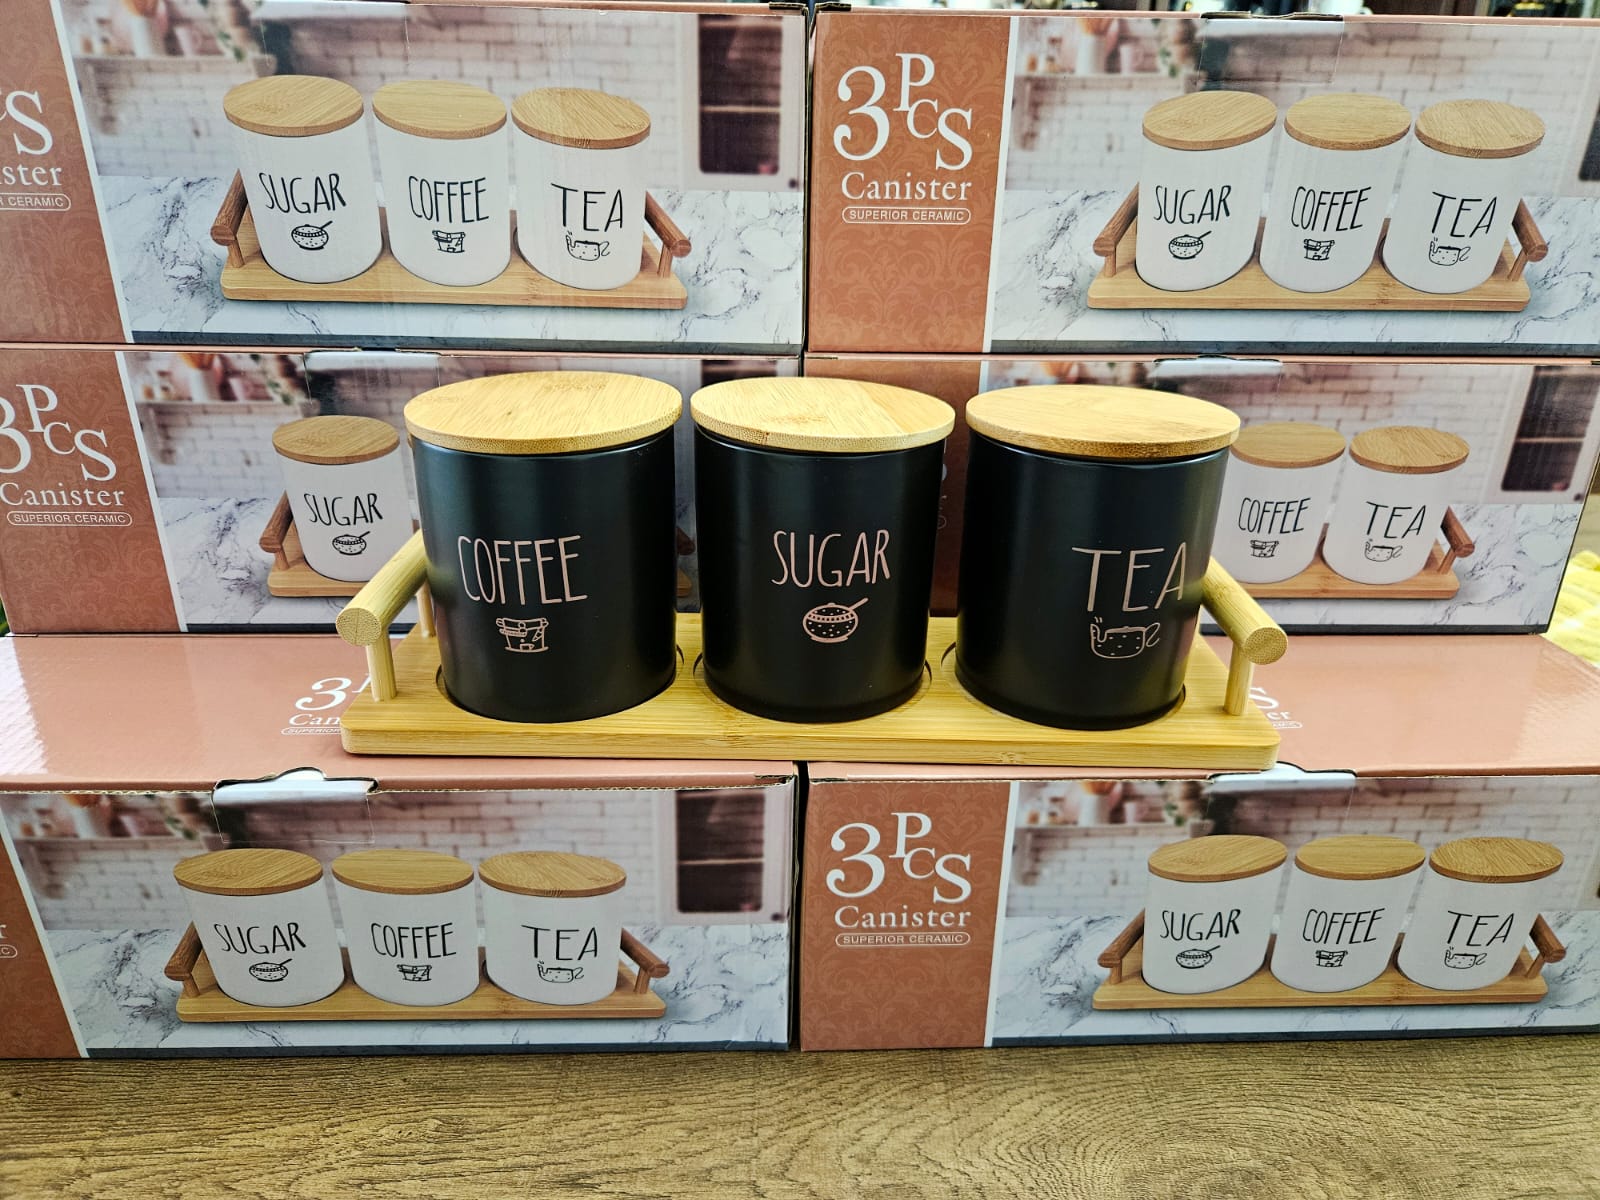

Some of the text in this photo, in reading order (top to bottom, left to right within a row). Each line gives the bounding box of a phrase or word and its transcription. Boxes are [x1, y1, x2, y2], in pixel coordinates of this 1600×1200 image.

[8, 196, 64, 207] CERAMIC
[257, 172, 347, 214] SUGAR
[408, 176, 489, 224] COFFEE
[841, 171, 972, 201] Canister
[1153, 184, 1232, 225] SUGAR
[550, 182, 624, 232] TEA
[849, 209, 965, 221] SUPERIOR CERAMIC
[1290, 185, 1372, 232] COFFEE
[1431, 191, 1497, 238] TEA
[0, 482, 125, 507] Canister
[303, 492, 383, 527] SUGAR
[13, 514, 127, 524] SUPERIOR CERAMIC
[1238, 496, 1312, 533] COFFEE
[1365, 500, 1426, 538] TEA
[457, 535, 589, 605] COFFEE
[771, 529, 892, 588] SUGAR
[1071, 542, 1188, 612] TEA
[834, 905, 971, 929] Canister
[1159, 908, 1242, 941] SUGAR
[1302, 907, 1386, 945] COFFEE
[1446, 910, 1515, 947] TEA
[213, 921, 307, 955] SUGAR
[371, 922, 457, 959] COFFEE
[520, 924, 600, 962] TEA
[843, 934, 964, 945] SUPERIOR CERAMIC
